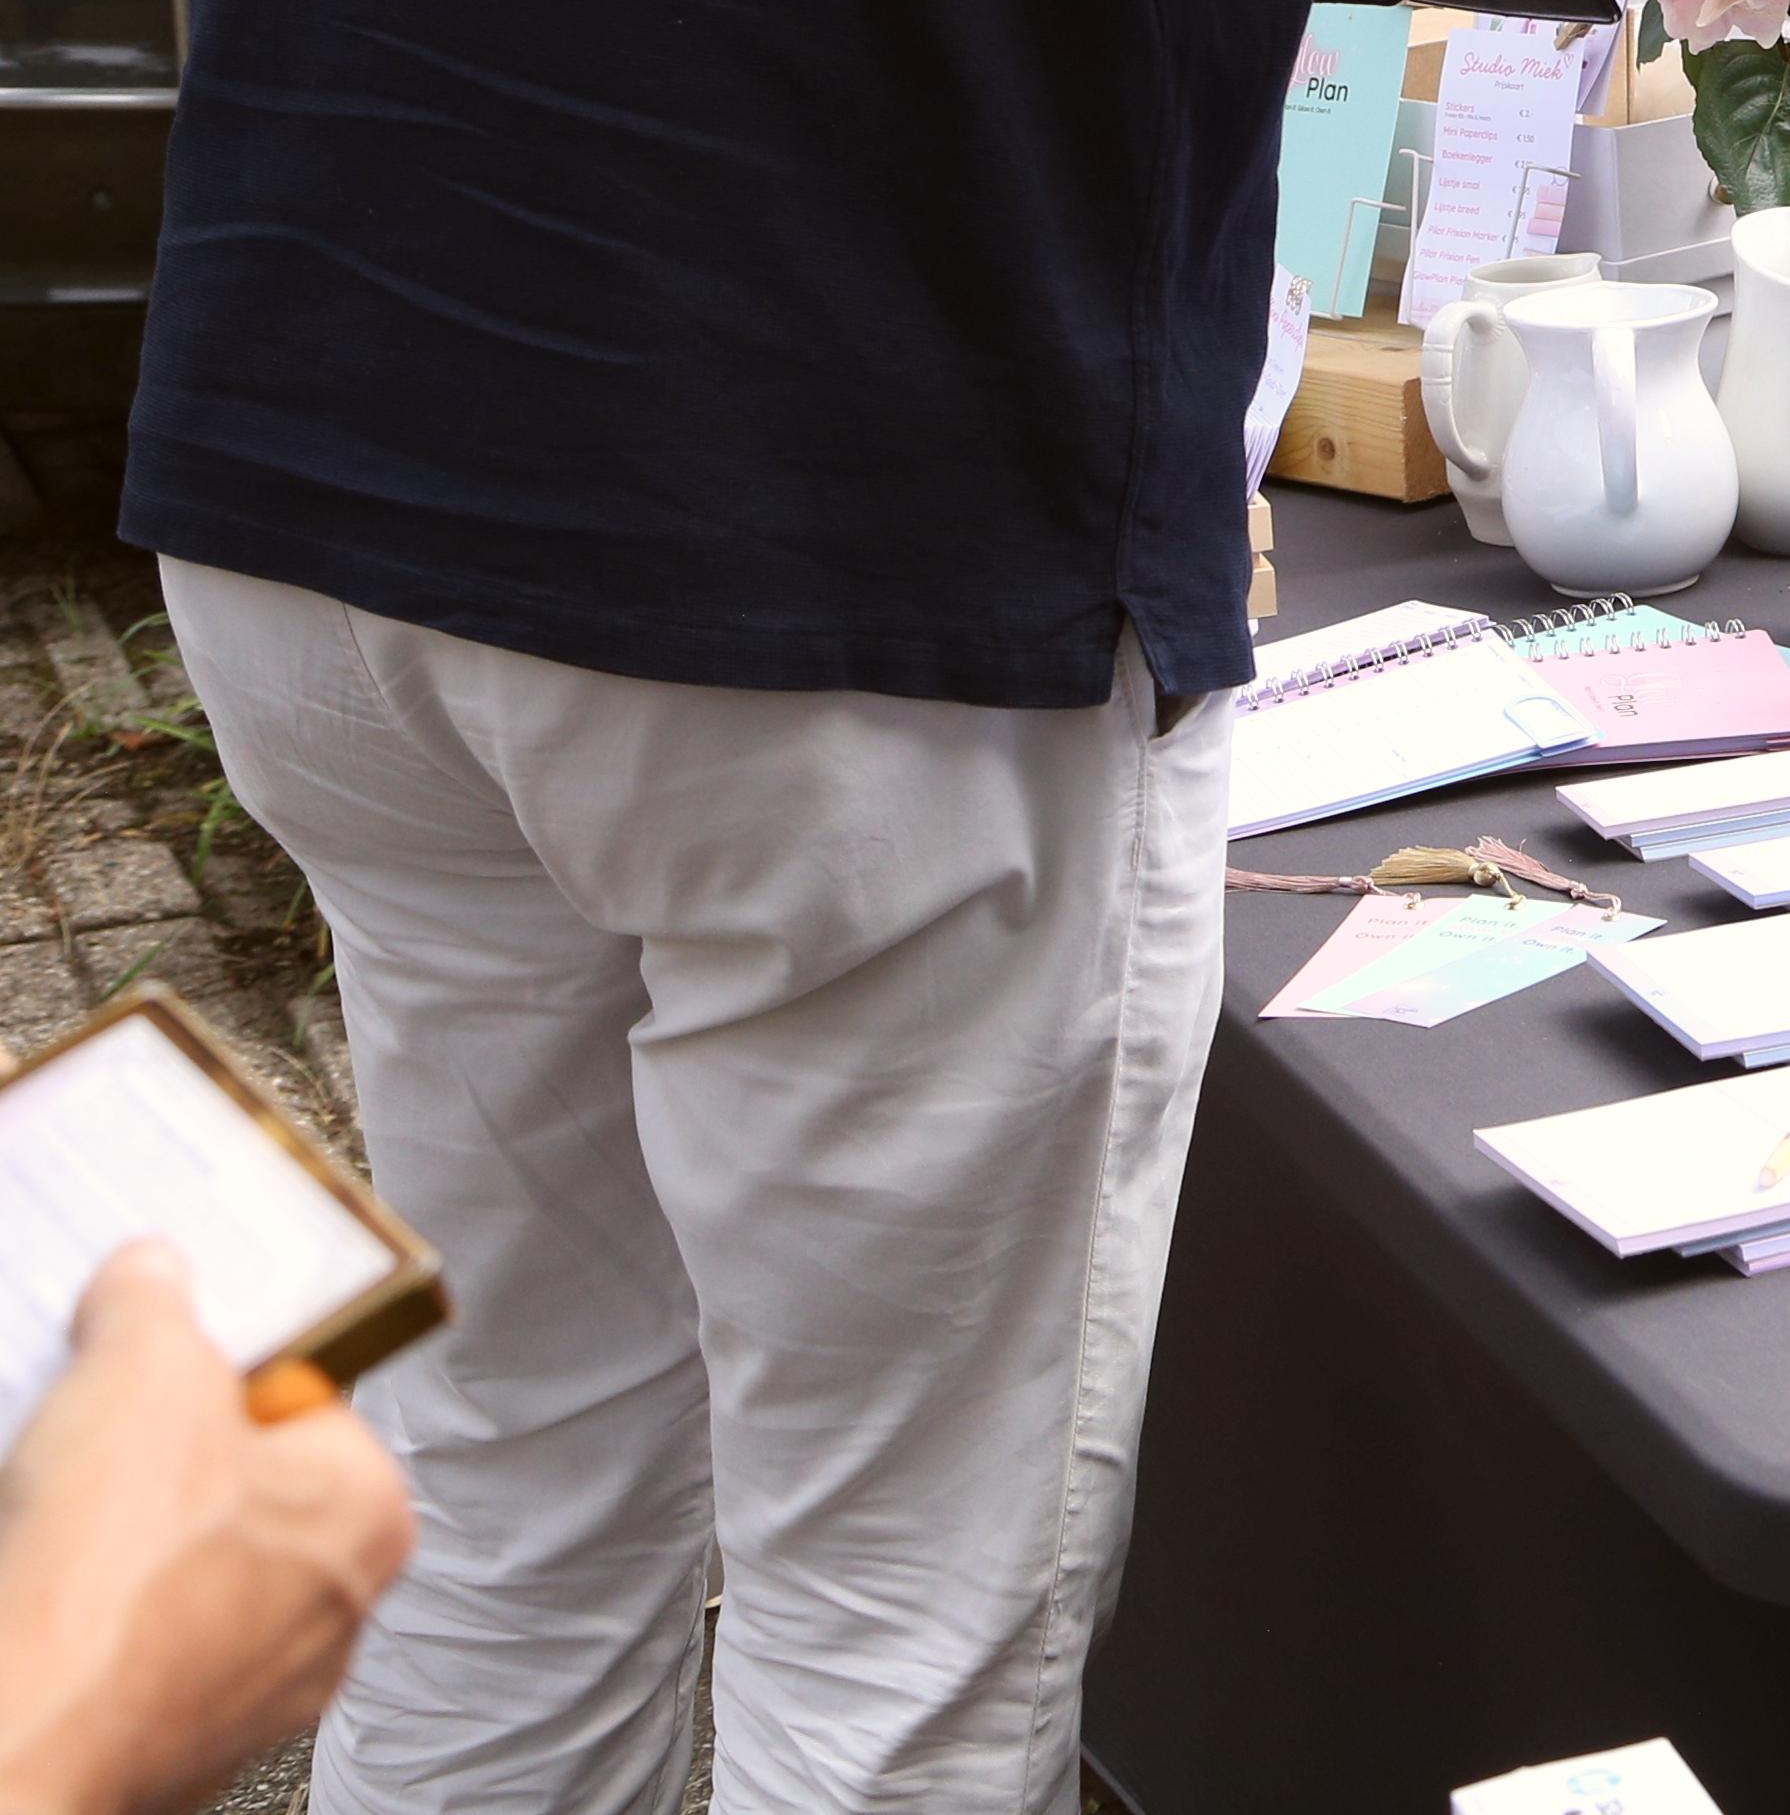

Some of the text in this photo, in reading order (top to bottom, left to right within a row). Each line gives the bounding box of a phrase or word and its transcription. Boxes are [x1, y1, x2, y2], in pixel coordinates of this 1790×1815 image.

[1460, 51, 1563, 80] Studio Miek
[1306, 77, 1349, 102] Plan
[1445, 102, 1475, 113] Stickers
[1443, 126, 1458, 136] Mini
[1460, 128, 1498, 141] Paperclips
[1442, 149, 1494, 165] Boekenlegger
[1463, 180, 1480, 190] smal
[1457, 203, 1481, 216] breed
[1428, 225, 1444, 236] Pilot
[1472, 230, 1499, 242] Marker
[1419, 248, 1437, 259] Pilot
[1466, 253, 1480, 264] Pen
[1414, 270, 1449, 283] GlowPlan
[1608, 694, 1638, 717] Plan
[1368, 917, 1409, 926] Plan
[1461, 916, 1498, 927] Plan
[1354, 932, 1396, 940] Own
[1439, 930, 1477, 940] Own
[1551, 925, 1586, 938] Plan
[1522, 938, 1557, 952] Own
